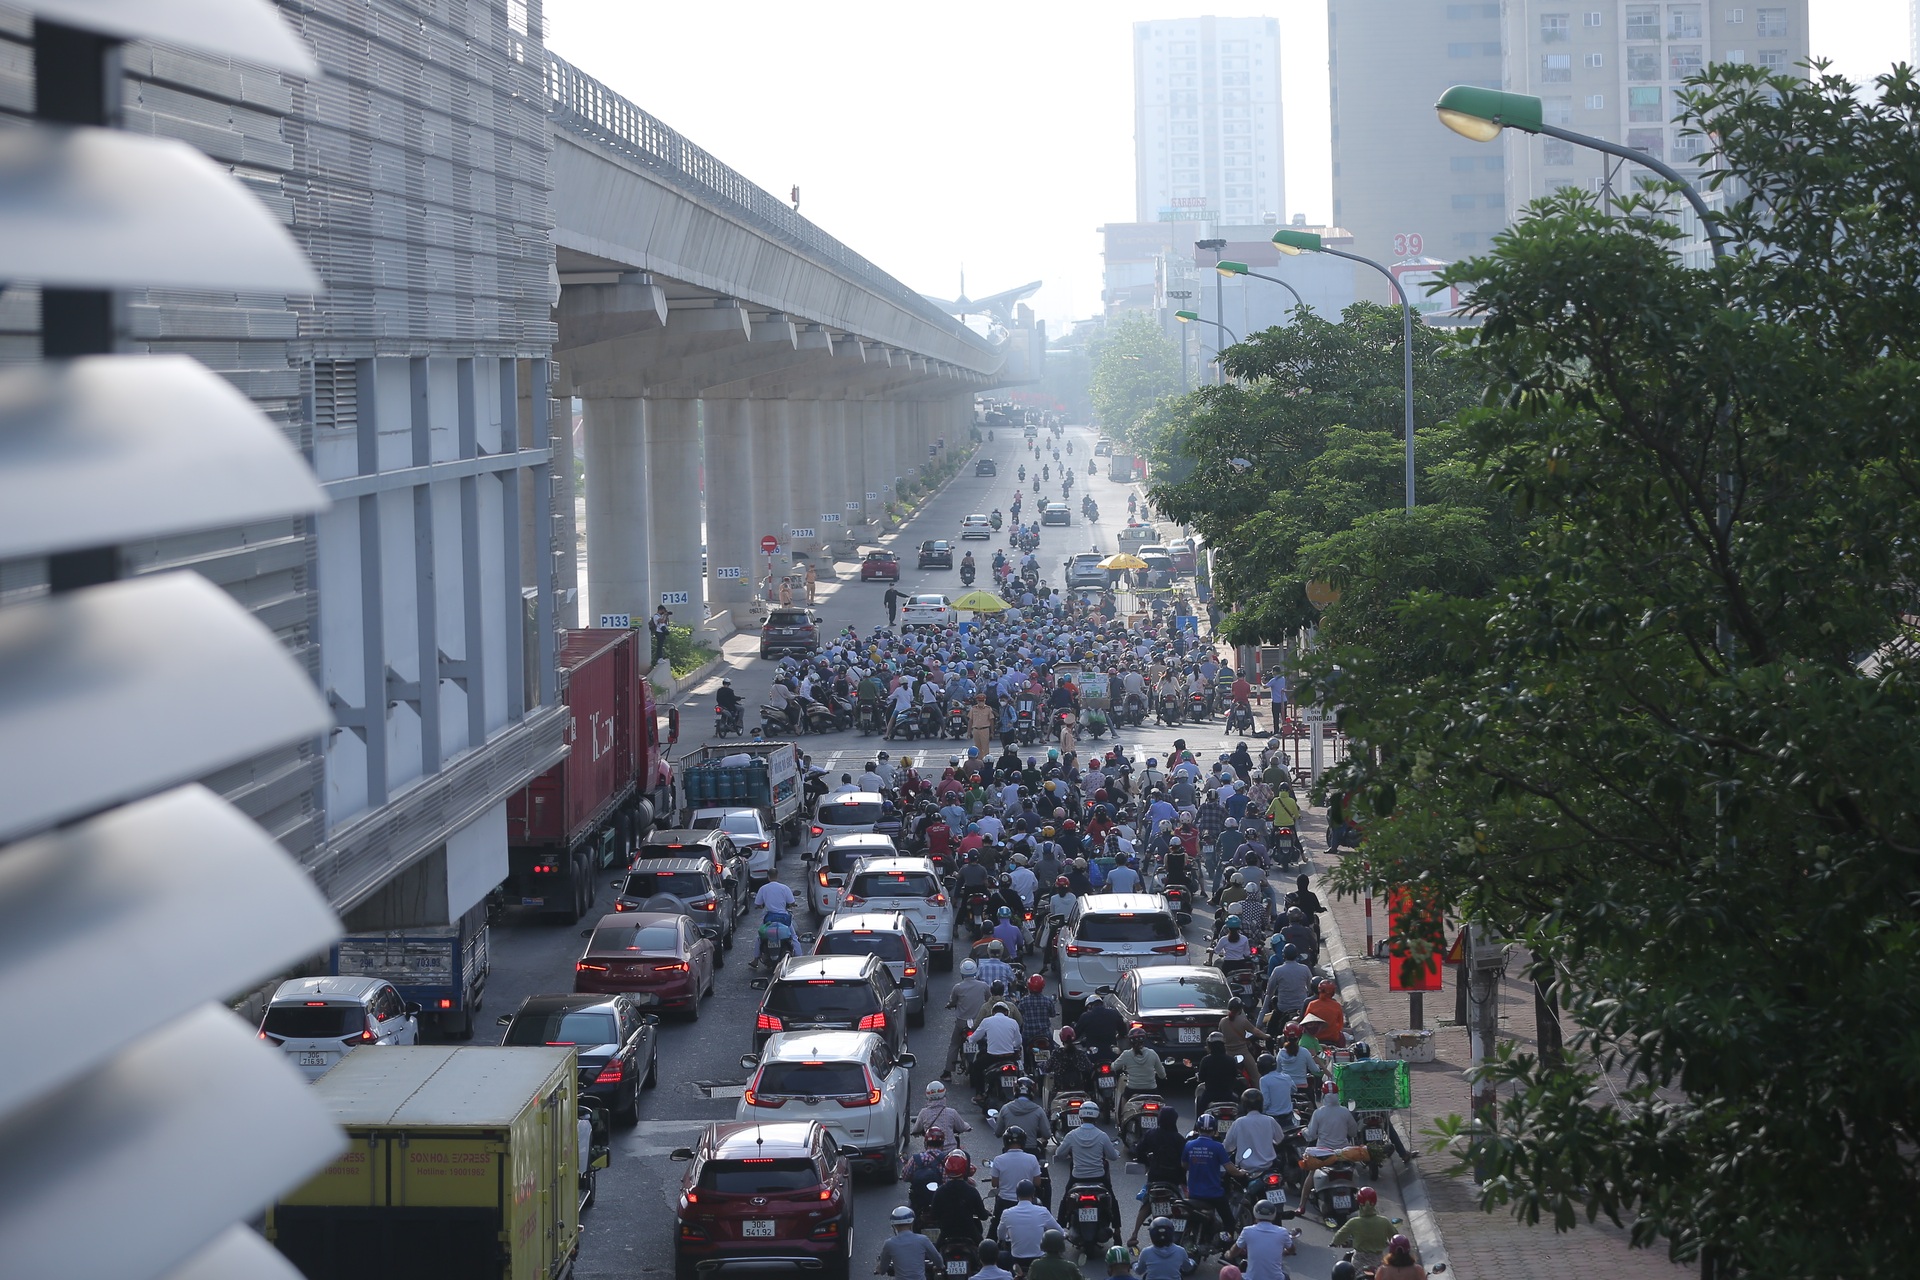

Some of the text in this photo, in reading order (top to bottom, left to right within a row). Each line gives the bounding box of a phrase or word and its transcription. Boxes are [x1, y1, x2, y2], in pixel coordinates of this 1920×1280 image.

[1393, 233, 1423, 257] 39
[792, 529, 814, 538] P137A
[718, 567, 740, 578] P135
[662, 592, 688, 604] P134
[601, 615, 629, 628] P133
[360, 958, 374, 968] 29H
[416, 957, 441, 969] 703.93
[452, 1153, 491, 1164] EXPRESS
[417, 1167, 486, 1177] Hotline: 19001962
[752, 1221, 766, 1229] 30G
[745, 1229, 773, 1237] 541.92
